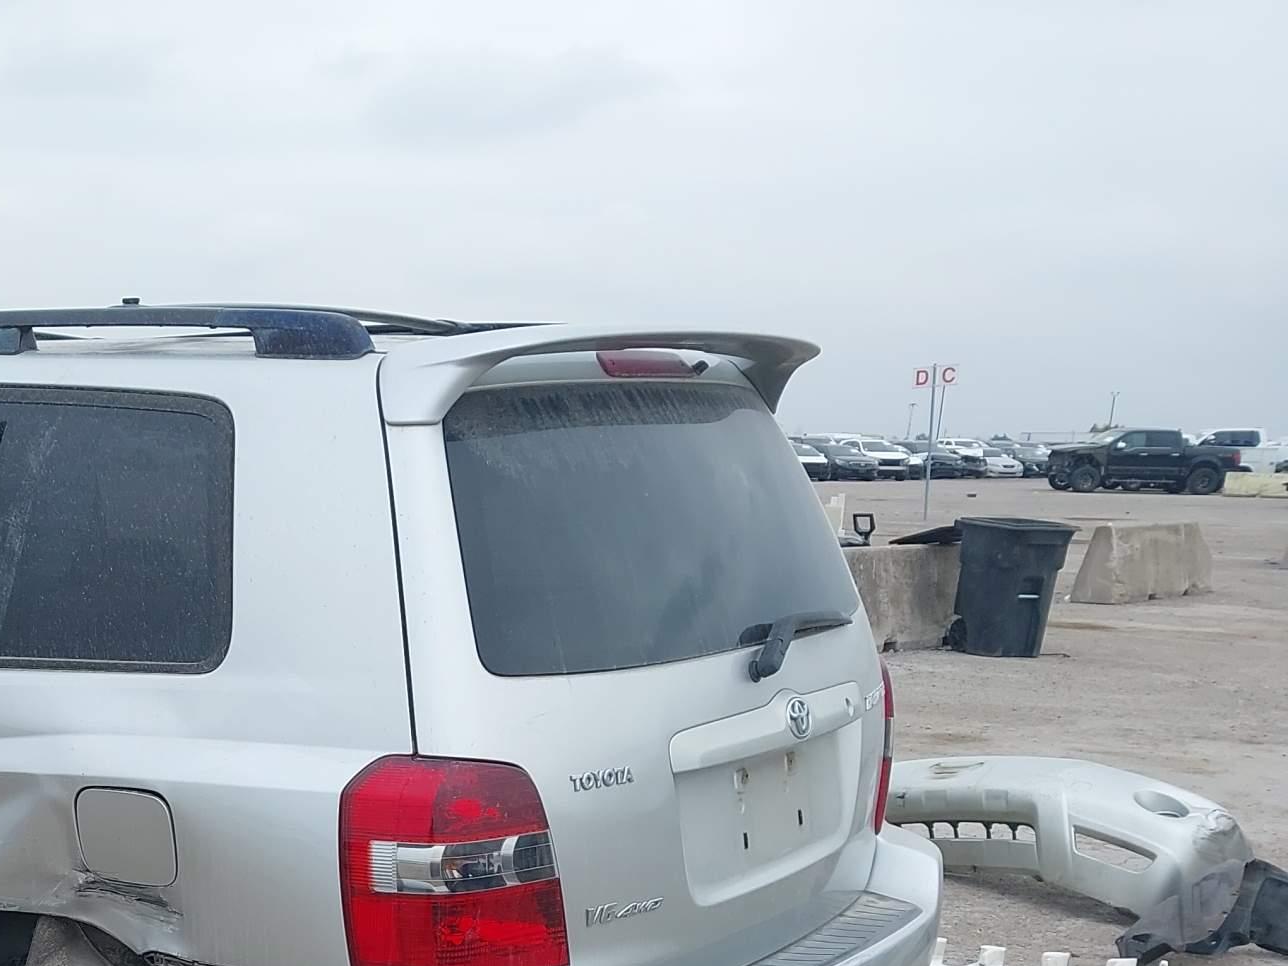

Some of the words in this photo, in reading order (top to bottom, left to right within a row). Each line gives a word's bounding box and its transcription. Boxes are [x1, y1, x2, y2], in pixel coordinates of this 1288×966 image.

[915, 369, 929, 386] D
[942, 367, 956, 383] C
[570, 766, 634, 792] TOYOTA
